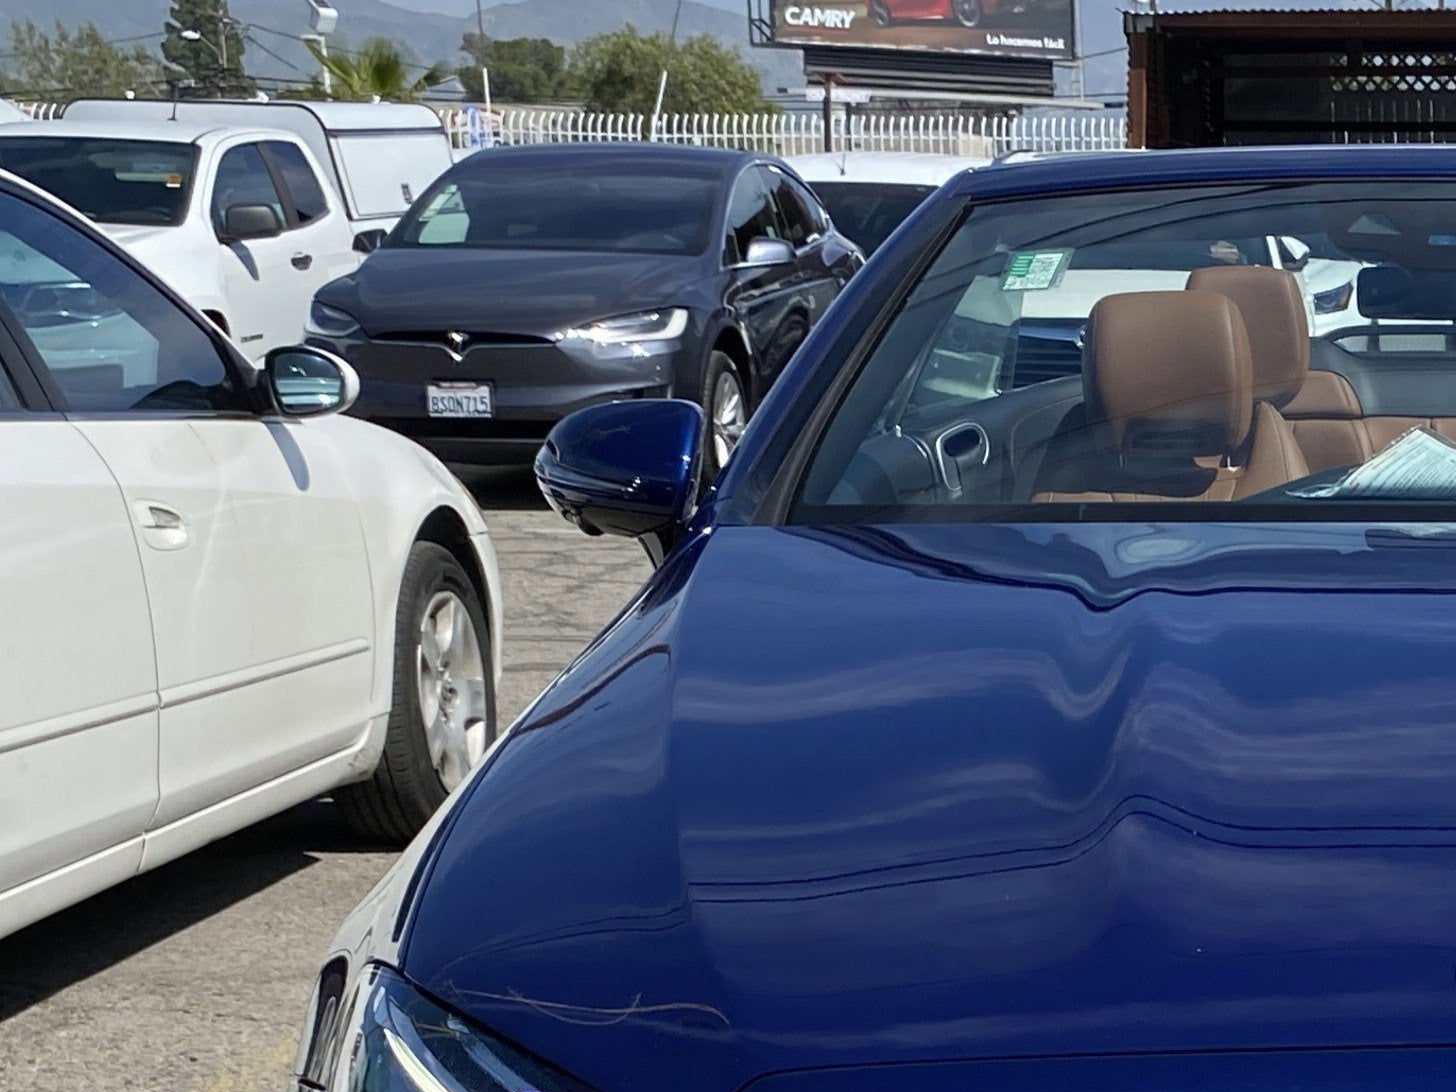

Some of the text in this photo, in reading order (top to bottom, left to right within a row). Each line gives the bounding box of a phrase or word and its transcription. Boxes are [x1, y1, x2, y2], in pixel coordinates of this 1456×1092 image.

[785, 6, 856, 29] CAMRY
[986, 33, 1000, 45] Lo
[1000, 34, 1043, 49] hacemos
